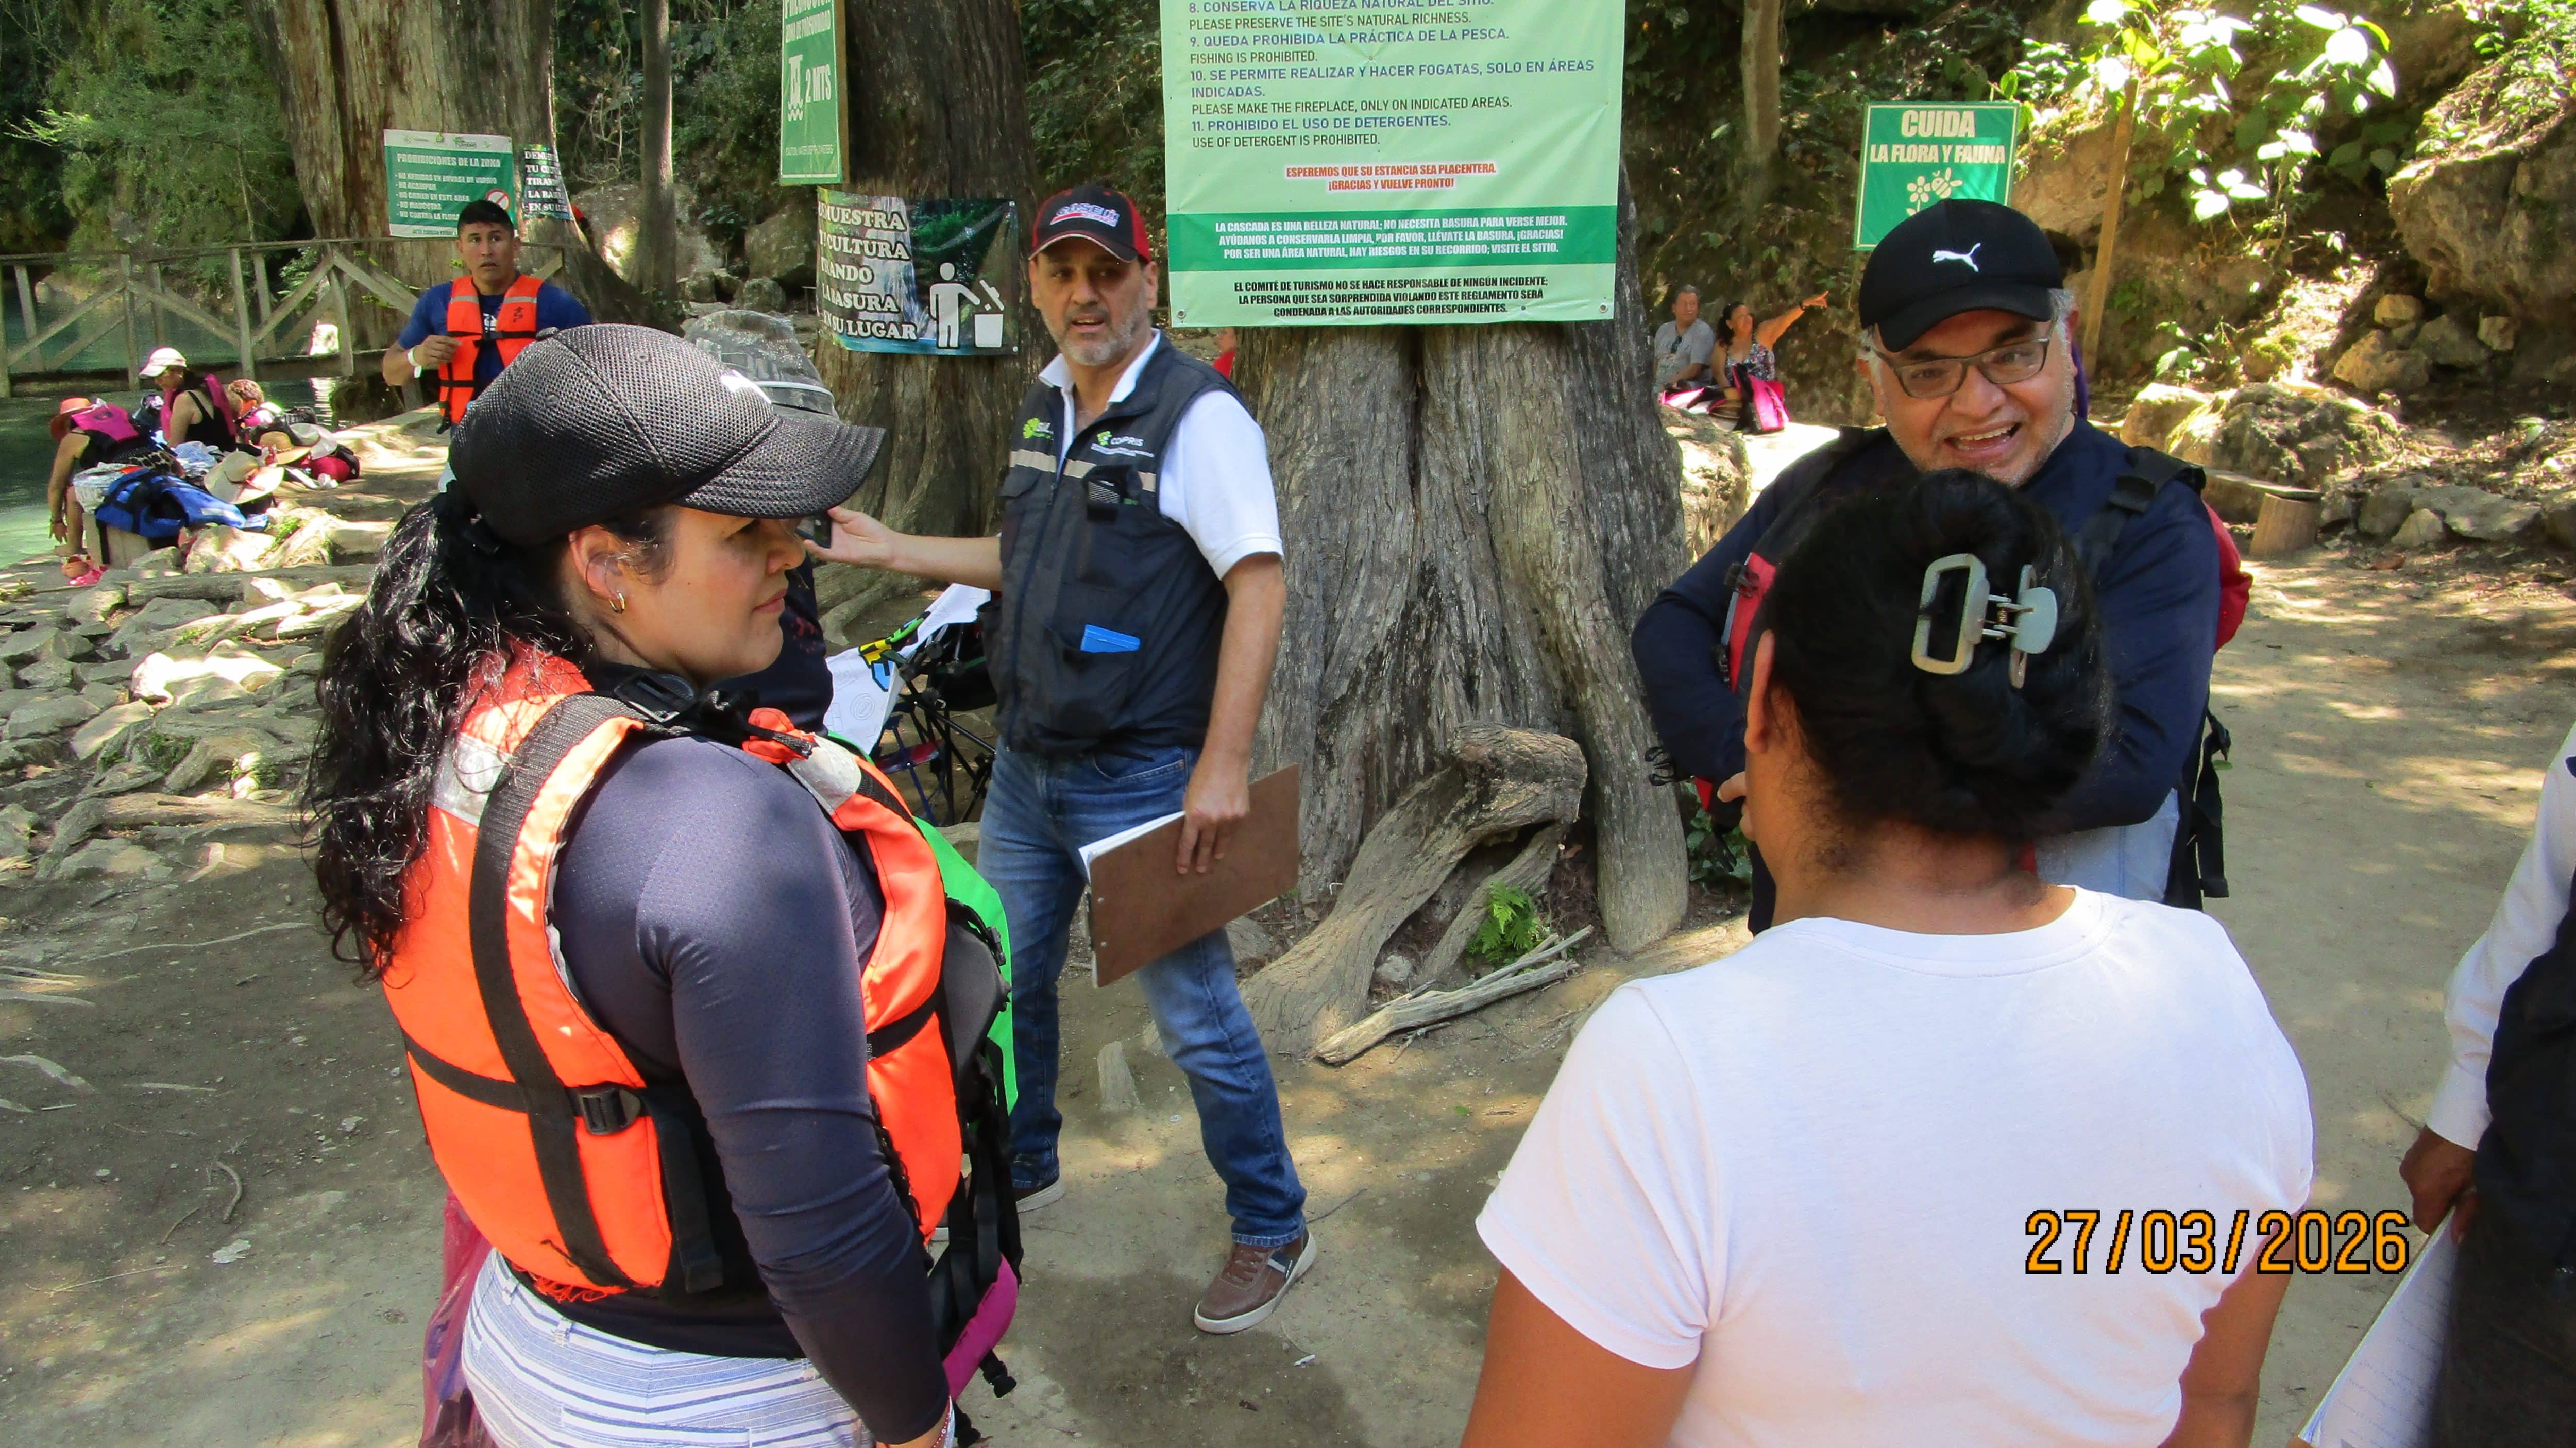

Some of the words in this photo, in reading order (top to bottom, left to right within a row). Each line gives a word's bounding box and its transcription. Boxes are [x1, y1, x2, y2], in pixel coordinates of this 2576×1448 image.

[1189, 3, 1199, 13] 8.
[1204, 1, 1275, 13] CONSERVA
[1280, 0, 1296, 11] LA
[1301, 0, 1357, 10] RIQUEZA
[1362, 0, 1423, 9] NATURAL
[1190, 19, 1231, 30] PLEASE
[1235, 18, 1293, 29] PRESERVE
[1296, 16, 1316, 27] THE
[1358, 14, 1408, 26] NATURAL
[1412, 12, 1471, 24] RICHNESS.
[1190, 37, 1199, 47] 9.
[1204, 35, 1248, 46] QUEDA
[1253, 33, 1325, 45] PROHIBIDA
[1329, 33, 1345, 44] LA
[1350, 29, 1414, 43] PRÁCTICA
[1419, 30, 1436, 41] DE
[1440, 29, 1457, 41] LA
[1462, 28, 1509, 40] PESCA.
[1190, 52, 1233, 64] FISHING
[1237, 52, 1247, 63] IS
[1250, 50, 1317, 63] PROHIBITED.
[1191, 70, 1206, 81] 10.
[1210, 70, 1226, 81] SE
[1231, 68, 1286, 80] PERMITE
[1291, 66, 1355, 79] REALIZAR
[1359, 66, 1367, 77] Y
[1370, 65, 1414, 77] HACER
[1419, 63, 1482, 76] FOGATAS,
[1486, 62, 1522, 74] SOLO
[1526, 61, 1544, 72] EN
[1548, 58, 1594, 72] ÁREAS
[805, 69, 811, 103] 2
[812, 64, 832, 102] MTS
[1192, 86, 1265, 98] INDICADAS.
[1192, 104, 1233, 115] PLEASE
[1237, 103, 1268, 114] MAKE
[1271, 102, 1291, 113] THE
[1295, 101, 1357, 113] FIREPLACE,
[1361, 100, 1389, 111] ONLY
[1392, 99, 1408, 110] ON
[1411, 98, 1468, 110] INDICATED
[1471, 97, 1512, 108] AREAS.
[1192, 121, 1204, 131] 11.
[1208, 119, 1278, 131] PROHIBIDO
[1283, 119, 1298, 129] EL
[1302, 118, 1329, 129] USO
[1334, 117, 1350, 128] DE
[1355, 115, 1451, 128] DETERGENTES.
[1901, 110, 1975, 138] CUIDA
[1193, 137, 1214, 148] USE
[1217, 137, 1231, 147] OF
[1234, 135, 1297, 147] DETERGENT
[1300, 135, 1310, 146] IS
[1313, 134, 1380, 146] PROHIBITED.
[470, 158, 479, 167] LA
[1870, 144, 1889, 163] LA
[1891, 144, 1939, 163] FLORA
[1941, 144, 1954, 163] Y
[1954, 145, 2006, 164] FAUNA
[1286, 166, 1340, 177] ESPEREMOS
[1341, 166, 1360, 177] QUE
[1361, 166, 1373, 176] SU
[1375, 164, 1419, 176] ESTANCIA
[1420, 164, 1438, 175] SEA
[1439, 163, 1496, 174] PLACENTERA.
[1328, 179, 1371, 191] ¡GRACIAS
[1372, 179, 1380, 189] Y
[1380, 178, 1413, 189] VUELVE
[1415, 178, 1454, 189] PRONTO!
[1215, 222, 1226, 232] LA
[1227, 222, 1269, 232] CASCADA
[1271, 221, 1282, 232] ES
[1283, 221, 1302, 231] UNA
[1303, 220, 1338, 231] BELLEZA
[1340, 219, 1382, 230] NATURAL;
[1384, 219, 1396, 230] NO
[1398, 218, 1440, 229] NECESITA
[1442, 217, 1479, 228] BASURA
[1480, 216, 1504, 227] PARA
[1506, 216, 1534, 227] VERSE
[1535, 215, 1567, 226] MEJOR.
[1219, 234, 1267, 246] AYÚDANOS
[1268, 235, 1276, 245] A
[1277, 234, 1340, 245] CONSERVARLA
[1376, 233, 1393, 243] POR
[1396, 232, 1426, 243] FAVOR,
[1428, 230, 1463, 242] LLÉVATE
[1465, 231, 1476, 241] LA
[1517, 229, 1564, 241] ¡GRACIAS!
[827, 234, 909, 260] CULTURA
[1224, 249, 1242, 259] POR
[1243, 248, 1261, 259] SER
[1262, 248, 1280, 258] UNA
[1281, 246, 1305, 258] ÁREA
[1306, 247, 1348, 258] NATURAL,
[1349, 247, 1368, 257] HAY
[1368, 245, 1407, 257] RIESGOS
[1409, 245, 1420, 255] EN
[1422, 245, 1433, 255] SU
[1491, 243, 1520, 254] VISITE
[1521, 243, 1531, 253] EL
[1532, 242, 1558, 253] SITIO.
[1234, 282, 1243, 292] EL
[1245, 280, 1278, 292] COMITÉ
[1280, 281, 1292, 291] DE
[1293, 281, 1333, 291] TURISMO
[1336, 280, 1348, 290] NO
[1350, 280, 1360, 290] SE
[1362, 280, 1385, 289] HACE
[1387, 278, 1449, 289] RESPONSABLE
[1450, 278, 1462, 288] DE
[1463, 276, 1498, 287] NINGÚN
[831, 287, 898, 312] BASURA
[1239, 295, 1249, 305] LA
[1250, 295, 1291, 304] PERSONA
[1292, 294, 1309, 304] QUE
[1311, 294, 1327, 303] SEA
[1329, 293, 1391, 303] SORPRENDIDA
[1393, 292, 1436, 302] VIOLANDO
[1438, 291, 1460, 301] ESTE
[1461, 289, 1519, 300] REGLAMENTO
[1520, 288, 1544, 299] SERÁ
[1274, 306, 1327, 317] CONDENADA
[1328, 307, 1335, 316] A
[1336, 306, 1351, 316] LAS
[1353, 305, 1415, 315] AUTORIDADES
[1416, 303, 1507, 315] CORRESPONDIENTES.
[832, 316, 844, 333] SU
[846, 320, 917, 340] LUGAR
